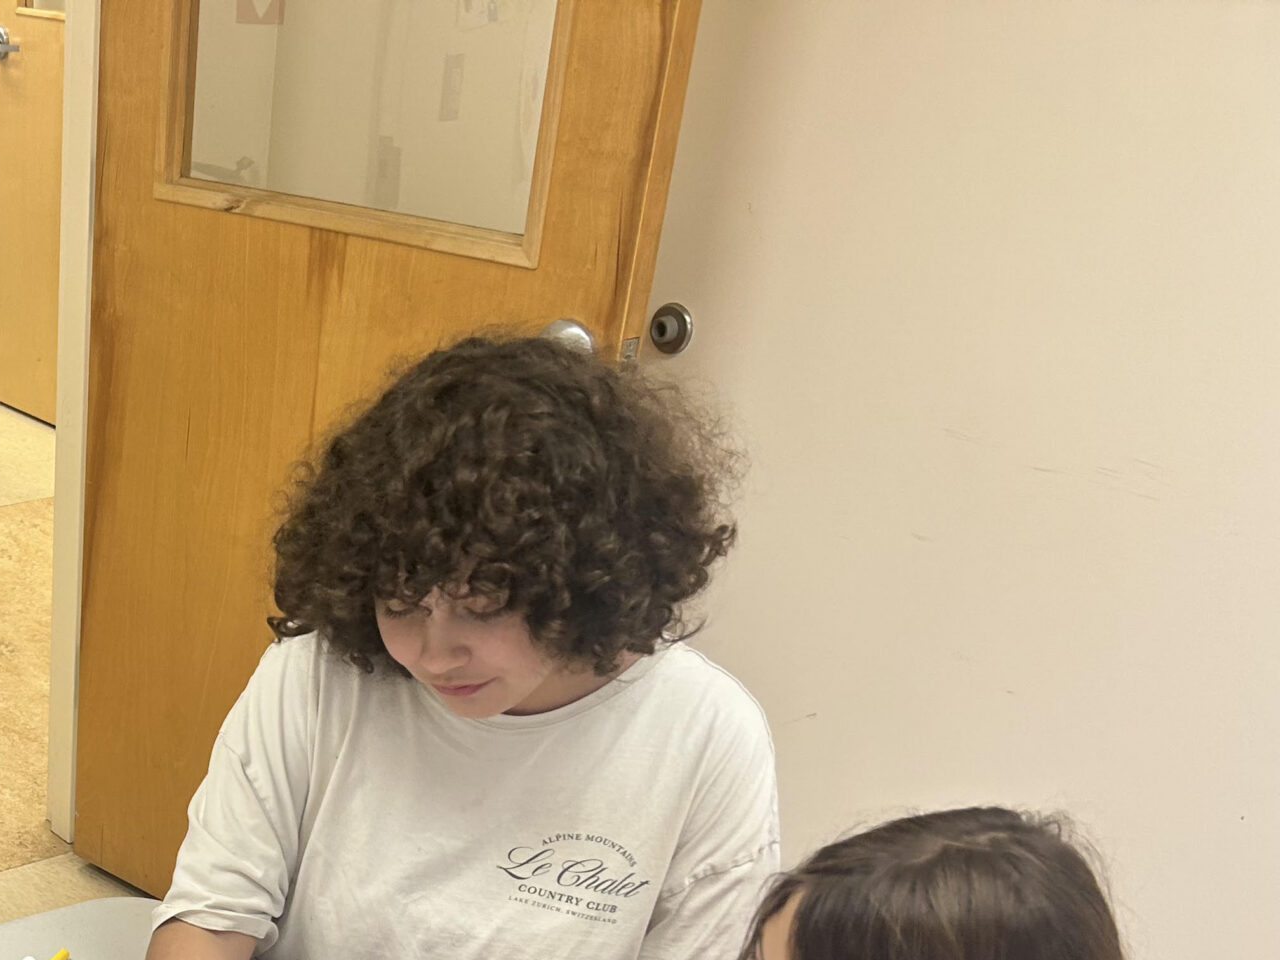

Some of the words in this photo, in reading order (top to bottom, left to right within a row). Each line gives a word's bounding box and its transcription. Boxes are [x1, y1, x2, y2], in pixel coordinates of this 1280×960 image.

[542, 833, 582, 846] ALPINE
[585, 834, 637, 868] MOUNTAINS
[496, 846, 555, 880] Le
[557, 859, 650, 898] Chalet
[509, 895, 528, 904] LAKE
[518, 884, 583, 906] COUNTRY
[586, 901, 618, 913] CLUB
